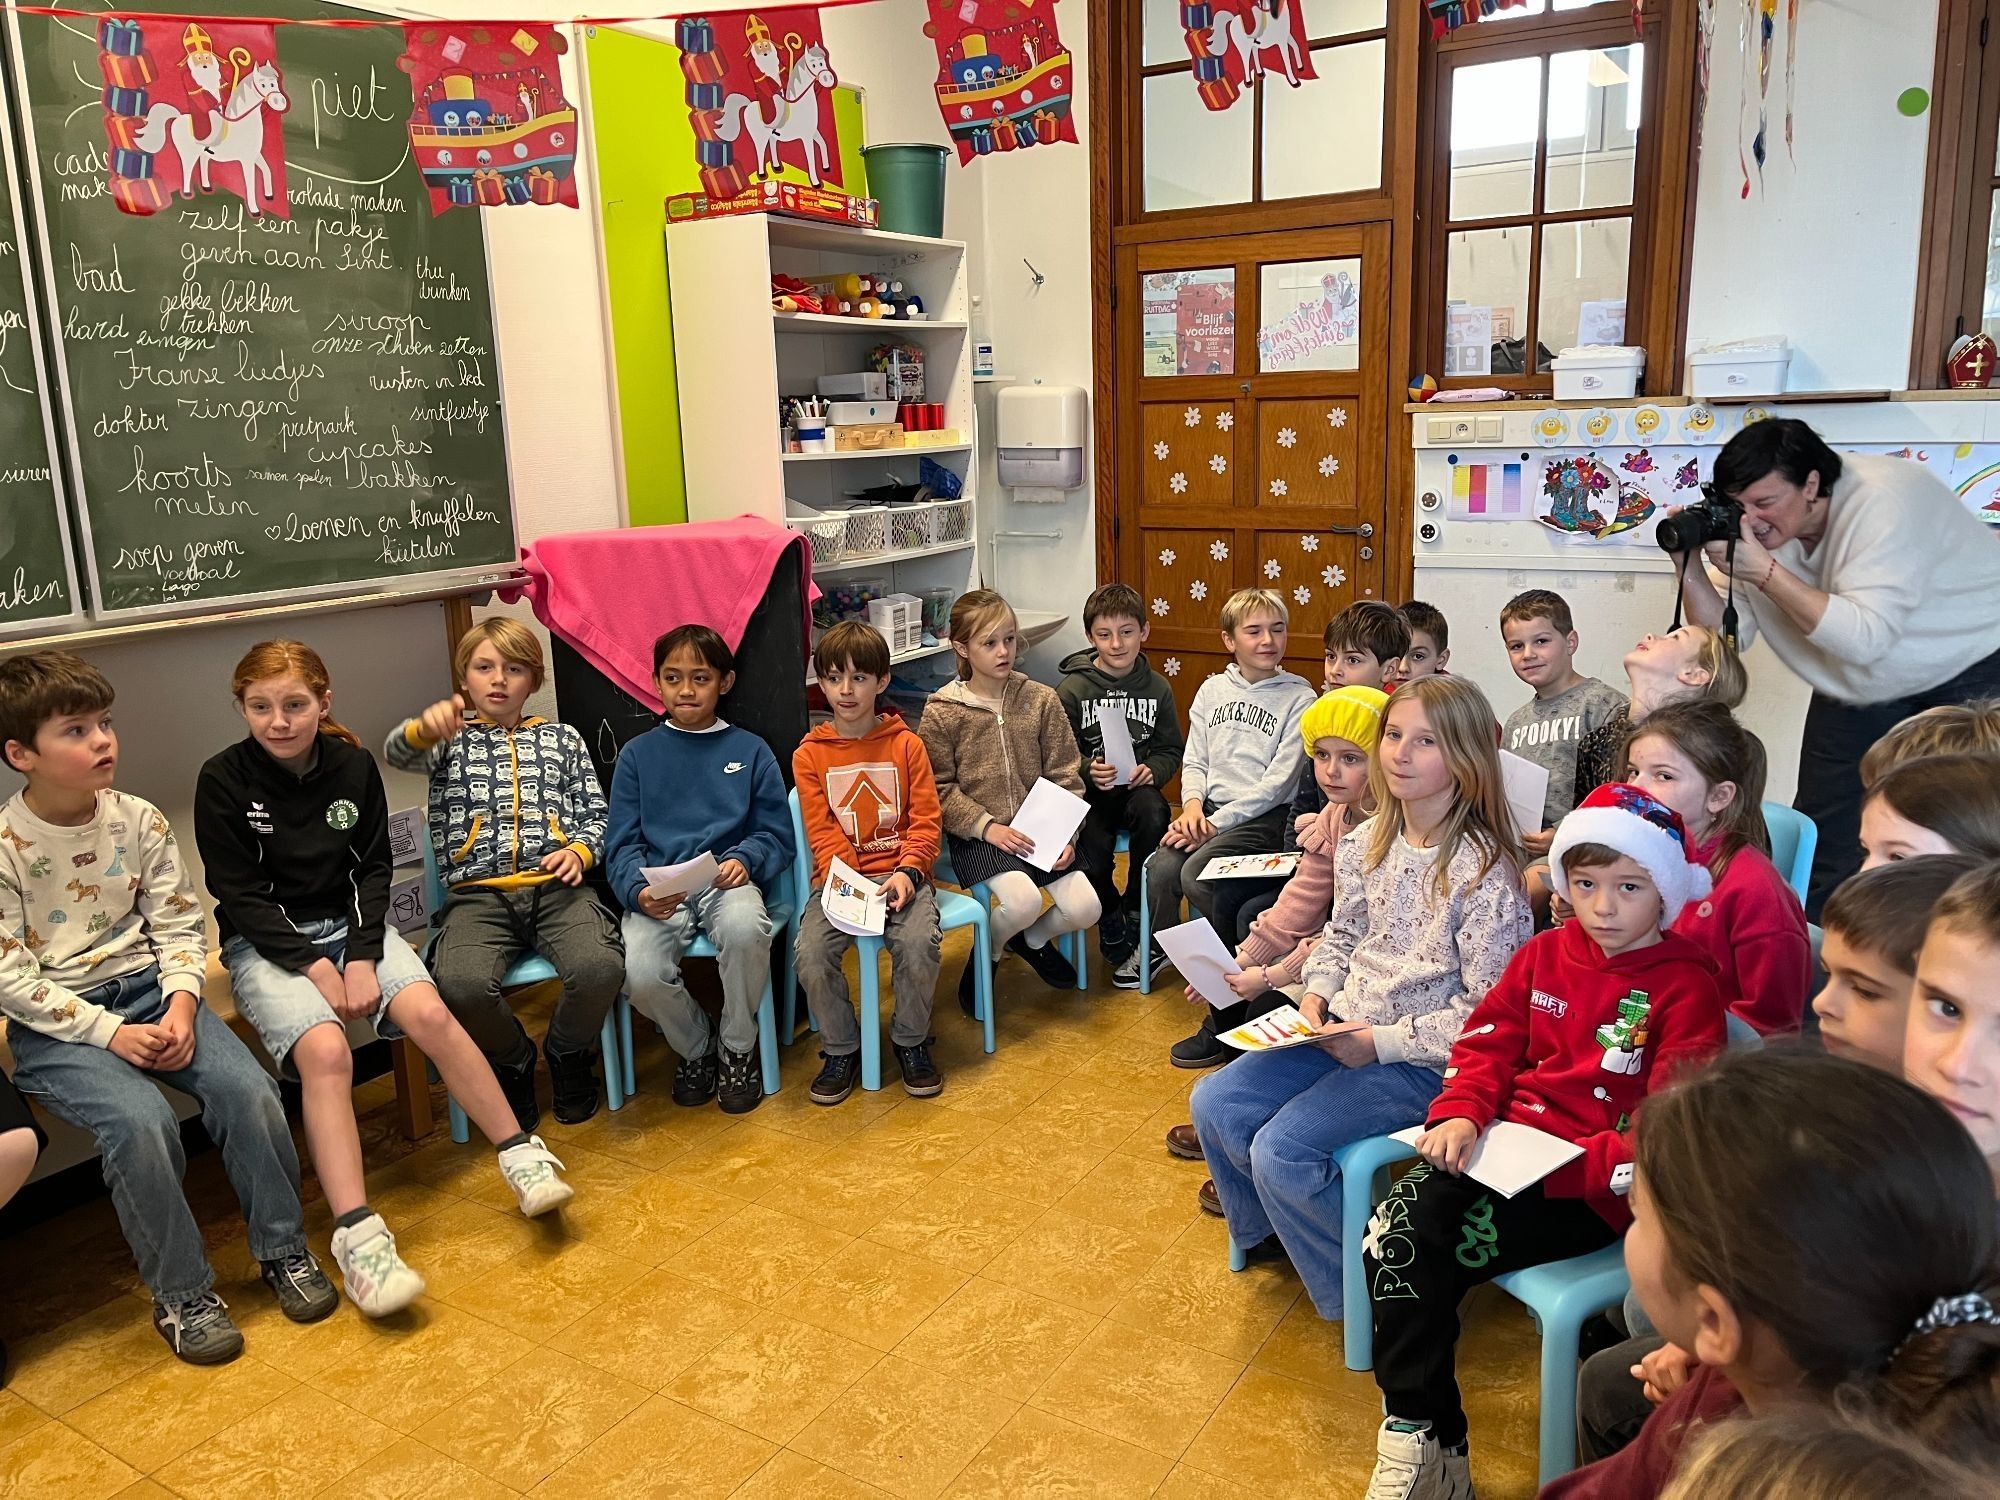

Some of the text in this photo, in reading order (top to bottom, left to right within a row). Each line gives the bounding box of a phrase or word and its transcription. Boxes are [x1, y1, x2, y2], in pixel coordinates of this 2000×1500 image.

[310, 64, 394, 150] piet
[350, 182, 406, 212] maken
[177, 202, 390, 259] zelf een pakje
[70, 242, 136, 293] bad
[180, 242, 257, 282] geven
[264, 248, 327, 269] aan
[63, 305, 129, 340] hard
[159, 279, 301, 332] gekke bekken
[178, 309, 255, 335] trekken
[1202, 313, 1224, 328] Blijf
[311, 334, 364, 354] onze
[323, 309, 431, 348] siroop
[113, 339, 325, 402] Franse liedjes
[369, 356, 485, 392] rusten in bed
[93, 397, 297, 442] dokter zingen
[279, 405, 358, 453] pretpark
[117, 444, 232, 493] koorts
[307, 424, 433, 480] cupcakes
[244, 468, 333, 491] samen spelen
[347, 460, 457, 490] bakken
[154, 490, 259, 516] meten
[377, 515, 401, 533] en
[407, 493, 501, 538] knuffelen
[112, 544, 173, 576] soep
[374, 534, 456, 565] kietelen
[1208, 701, 1278, 737] JACK & JONES
[1510, 715, 1581, 750] SPOOKY!
[329, 799, 359, 817] TORHOUT
